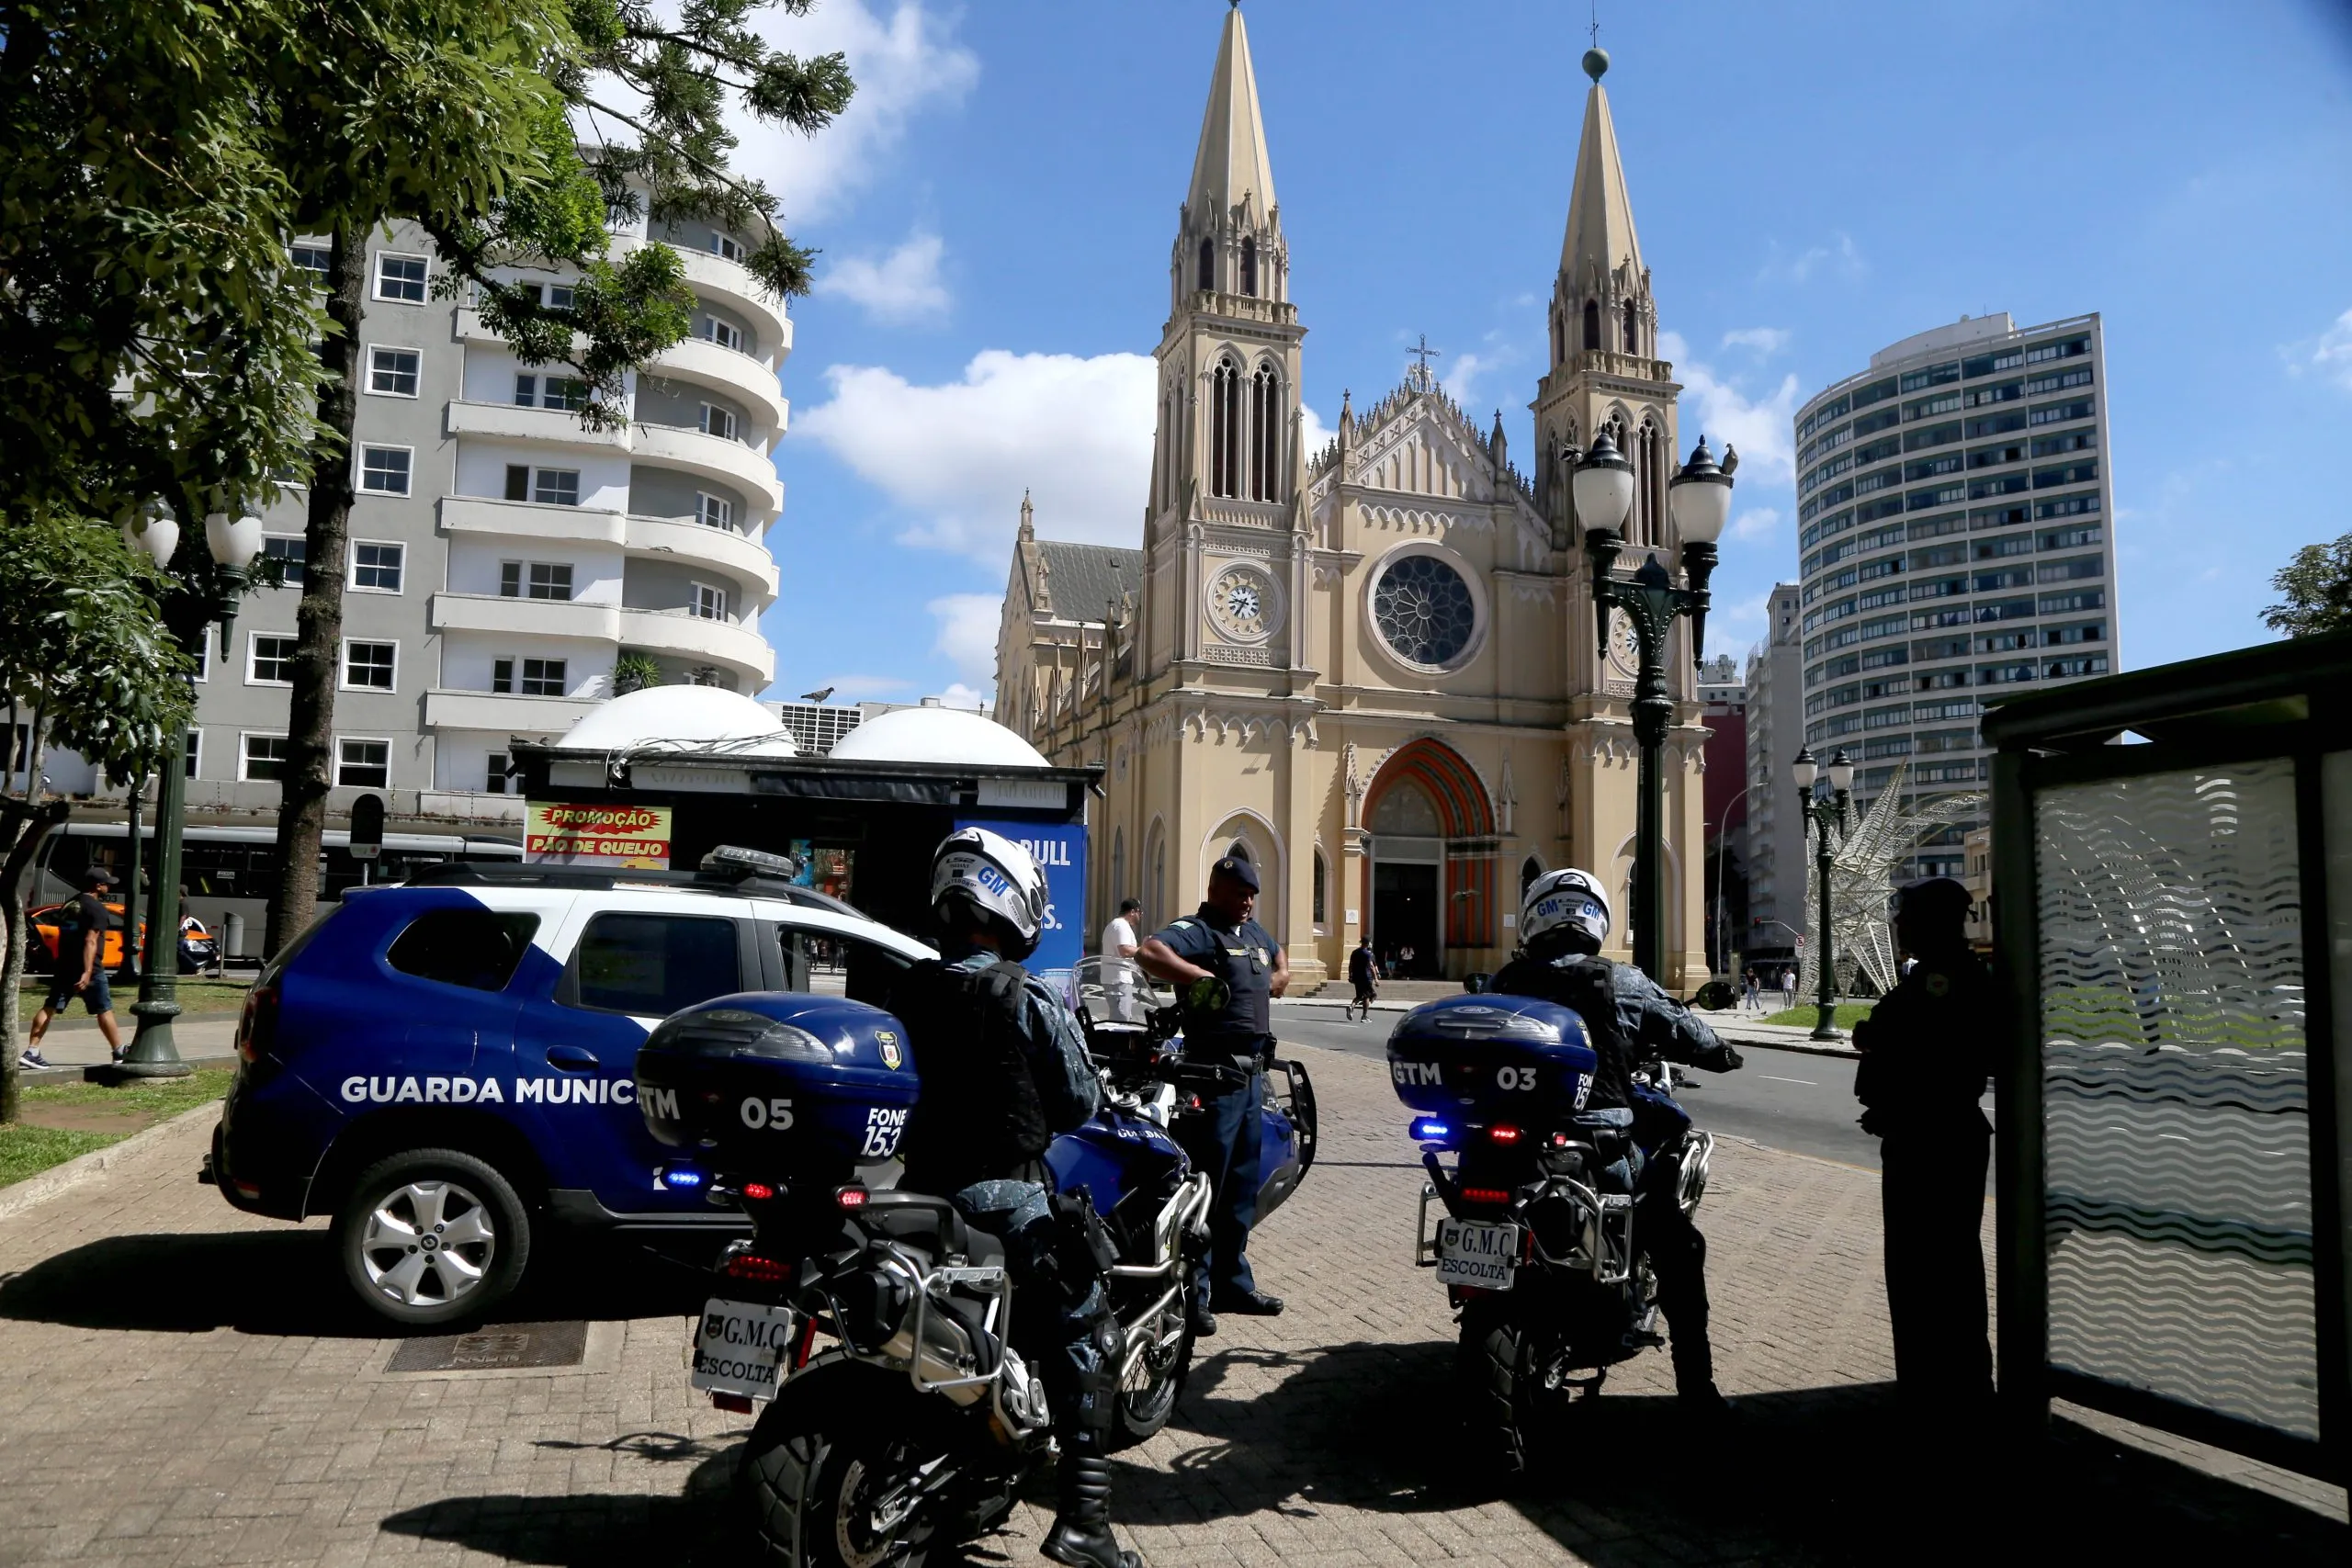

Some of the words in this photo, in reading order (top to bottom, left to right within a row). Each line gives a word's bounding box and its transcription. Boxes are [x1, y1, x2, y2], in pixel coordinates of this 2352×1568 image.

[551, 809, 650, 829] PROMOÇÃO
[531, 836, 568, 852] PÃO
[571, 840, 596, 853] DE
[599, 840, 662, 856] QUEIJO
[978, 866, 1010, 897] GM
[1537, 899, 1559, 917] GM
[1582, 901, 1601, 920] GM
[1393, 1061, 1442, 1086] GTM
[1497, 1066, 1536, 1091] 03
[1577, 1073, 1594, 1089] FON
[341, 1077, 504, 1103] GUARDA
[515, 1077, 639, 1104] MUNIC
[741, 1097, 794, 1131] 05
[867, 1108, 908, 1126] FONE
[860, 1125, 901, 1157] 153
[1442, 1258, 1507, 1280] ESCOLTA
[696, 1356, 775, 1385] ESCOLTA
